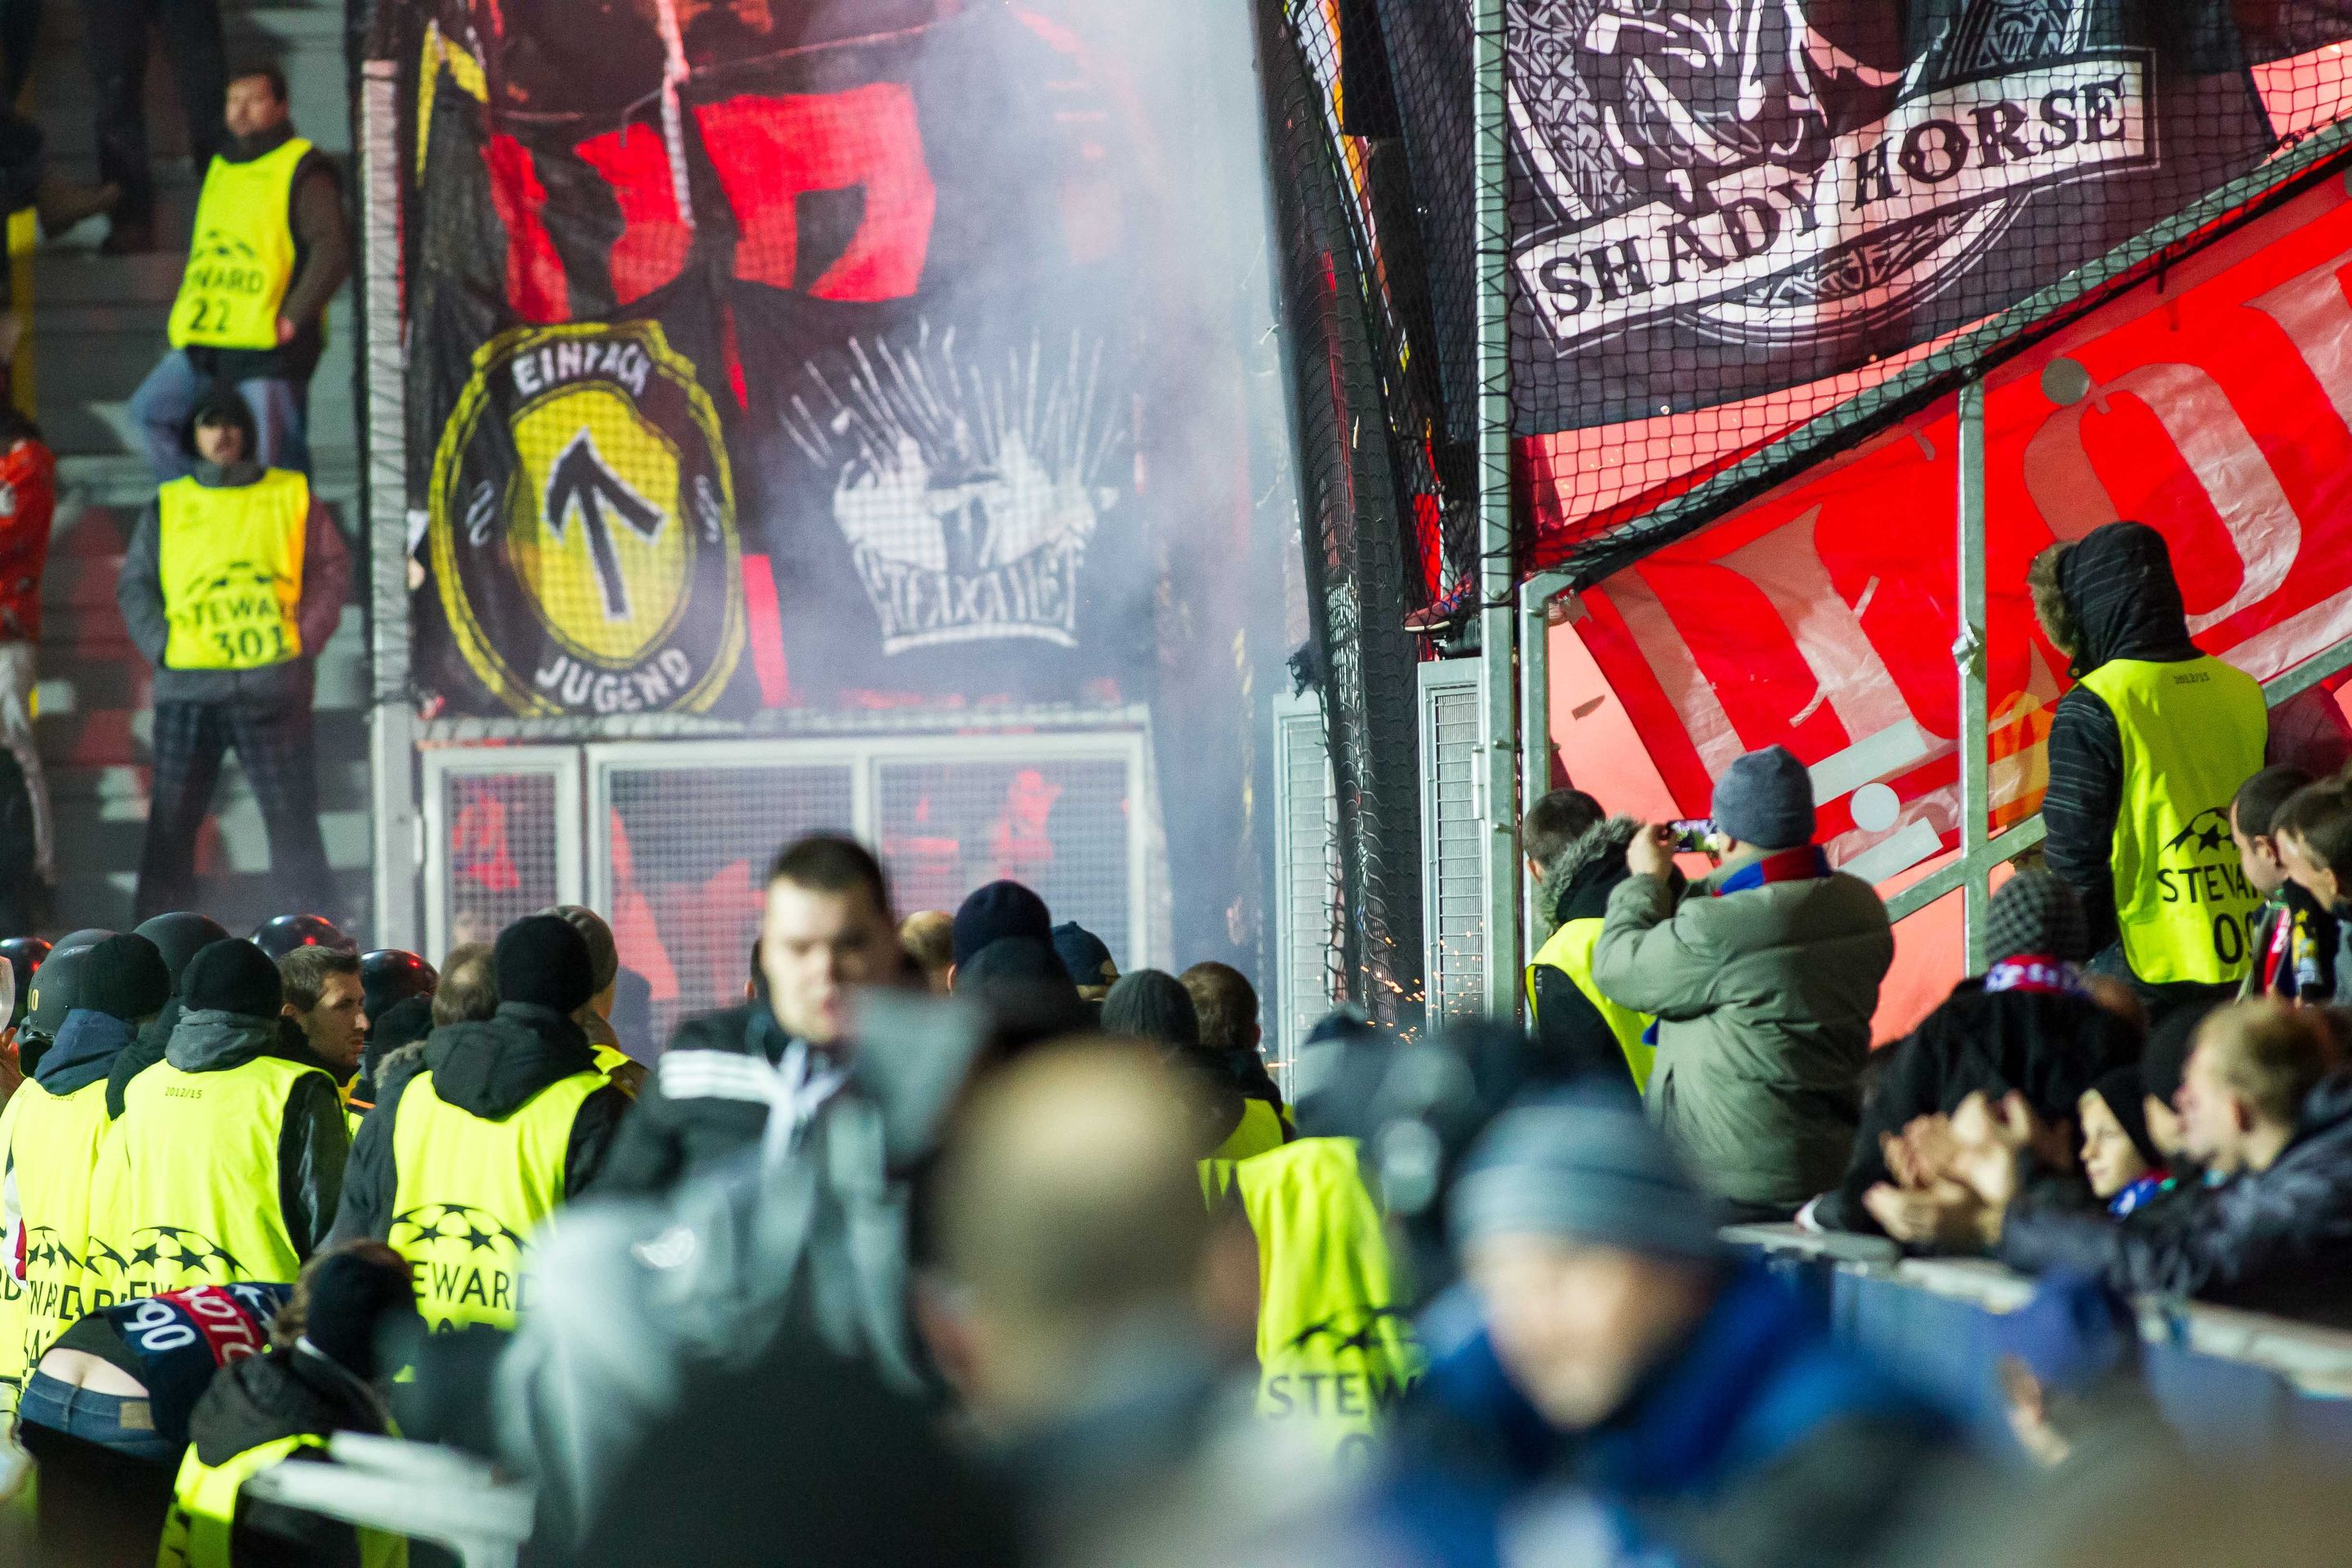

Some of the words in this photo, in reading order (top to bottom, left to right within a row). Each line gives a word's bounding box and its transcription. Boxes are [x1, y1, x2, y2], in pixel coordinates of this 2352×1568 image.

[1539, 168, 1826, 320] SHADY
[1850, 74, 2126, 212] HORSE
[189, 298, 229, 333] 22
[535, 648, 691, 714] JUGEND
[164, 1086, 203, 1099] 2012/15
